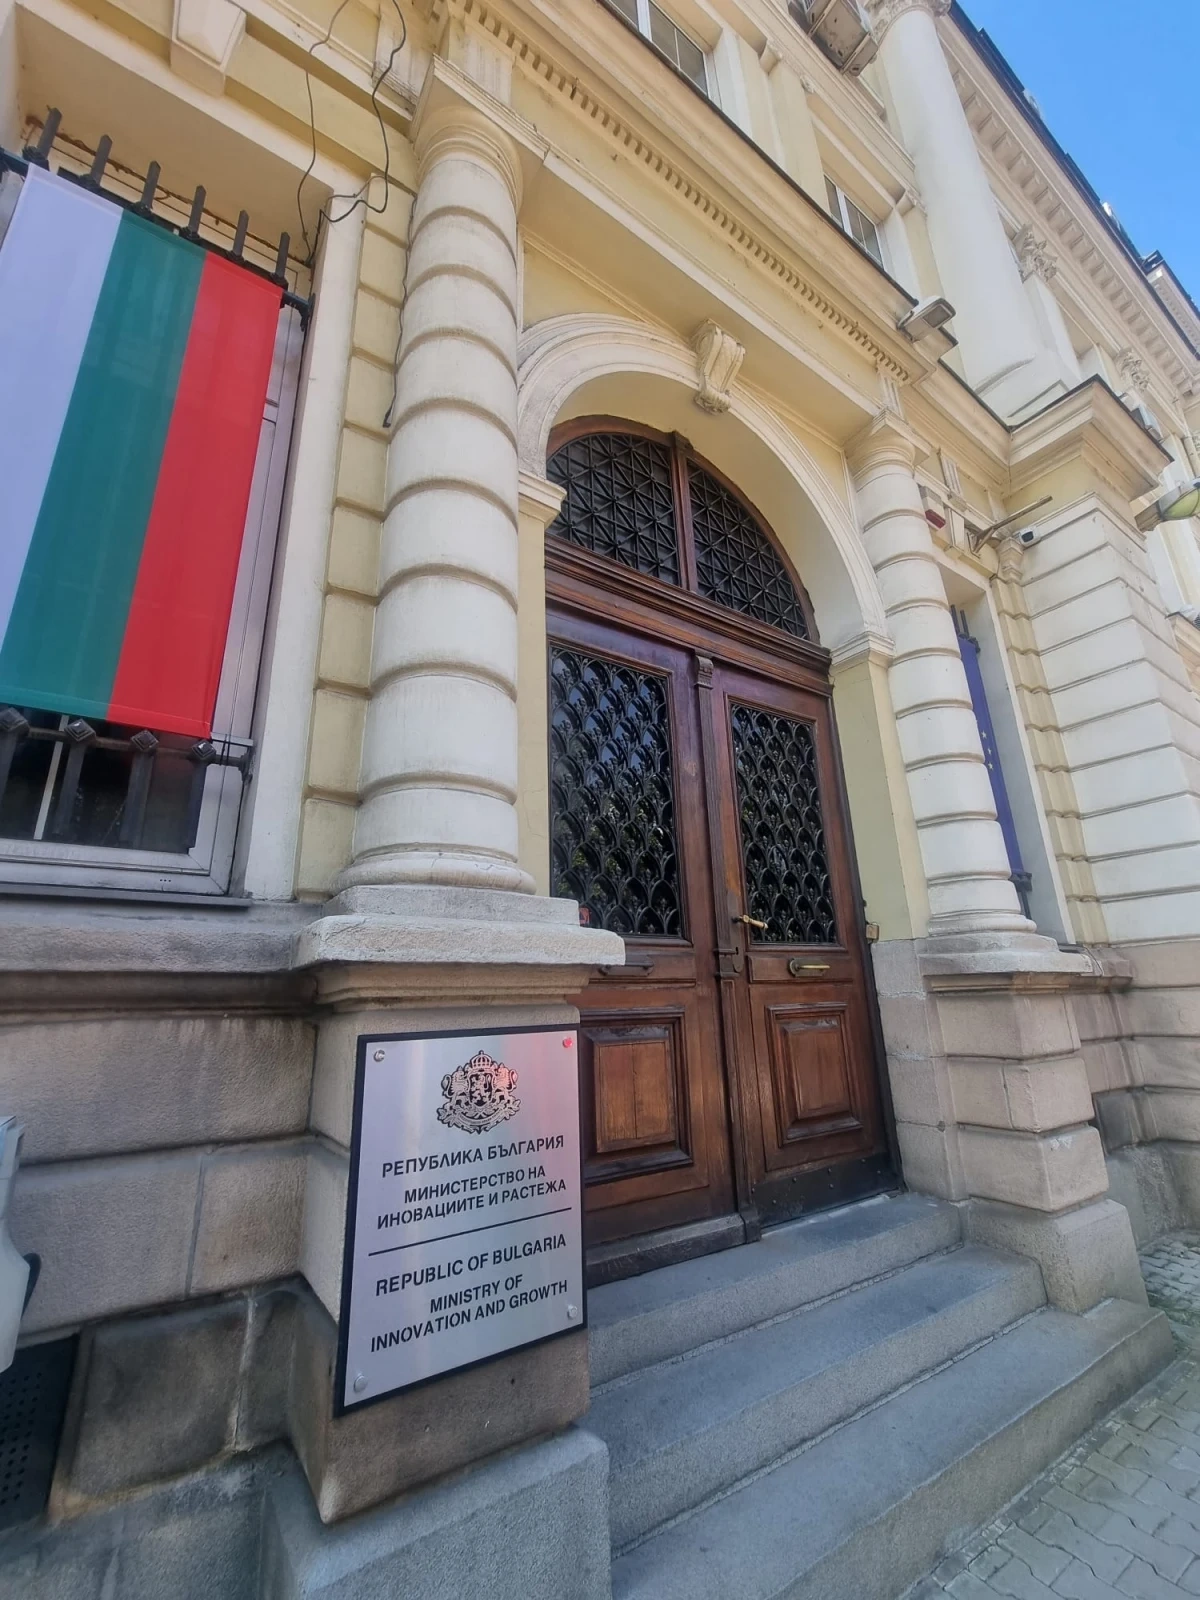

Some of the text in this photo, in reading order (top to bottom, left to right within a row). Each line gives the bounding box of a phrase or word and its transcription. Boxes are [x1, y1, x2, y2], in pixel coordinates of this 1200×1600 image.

[382, 1135, 564, 1178] РЕПУБЛИКА БЪЛГАРИЯ
[377, 1179, 566, 1229] ИНОВАЦИИТЕ И РАСТЕЖА
[404, 1165, 546, 1203] МИНИСТЕРСТВО НА
[376, 1234, 566, 1296] REPUBLIC OF BULGARIA
[371, 1280, 567, 1352] INNOVATION AND GROWTH
[430, 1274, 523, 1313] MINISTRY OF
